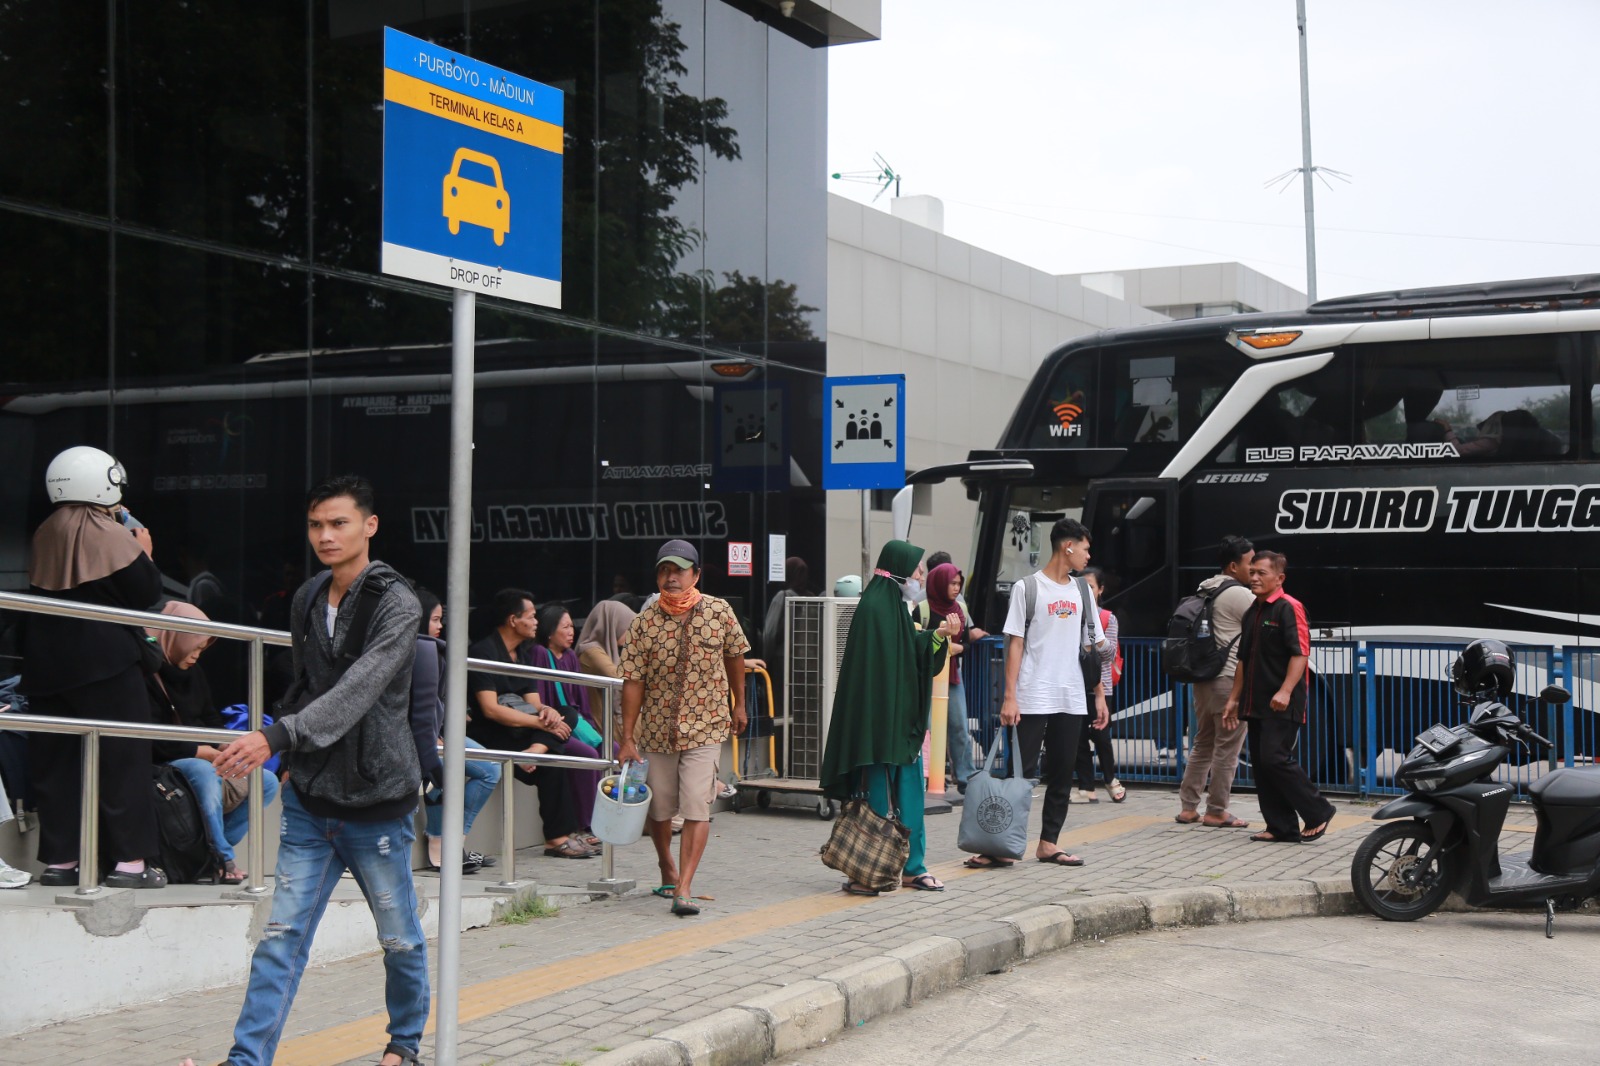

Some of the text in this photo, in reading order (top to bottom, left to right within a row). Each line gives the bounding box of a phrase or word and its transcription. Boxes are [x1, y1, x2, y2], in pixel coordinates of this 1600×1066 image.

[419, 52, 479, 87] PURBOYO
[490, 77, 534, 105] MADIUN
[429, 92, 524, 135] TERMINAL KELAS A
[450, 266, 502, 289] DROP OFF
[1049, 424, 1082, 437] WiFi
[1246, 443, 1461, 463] BUS PARAWANITA
[1197, 473, 1269, 484] JETBUS
[1275, 484, 1600, 534] SUDIRO TUNGG
